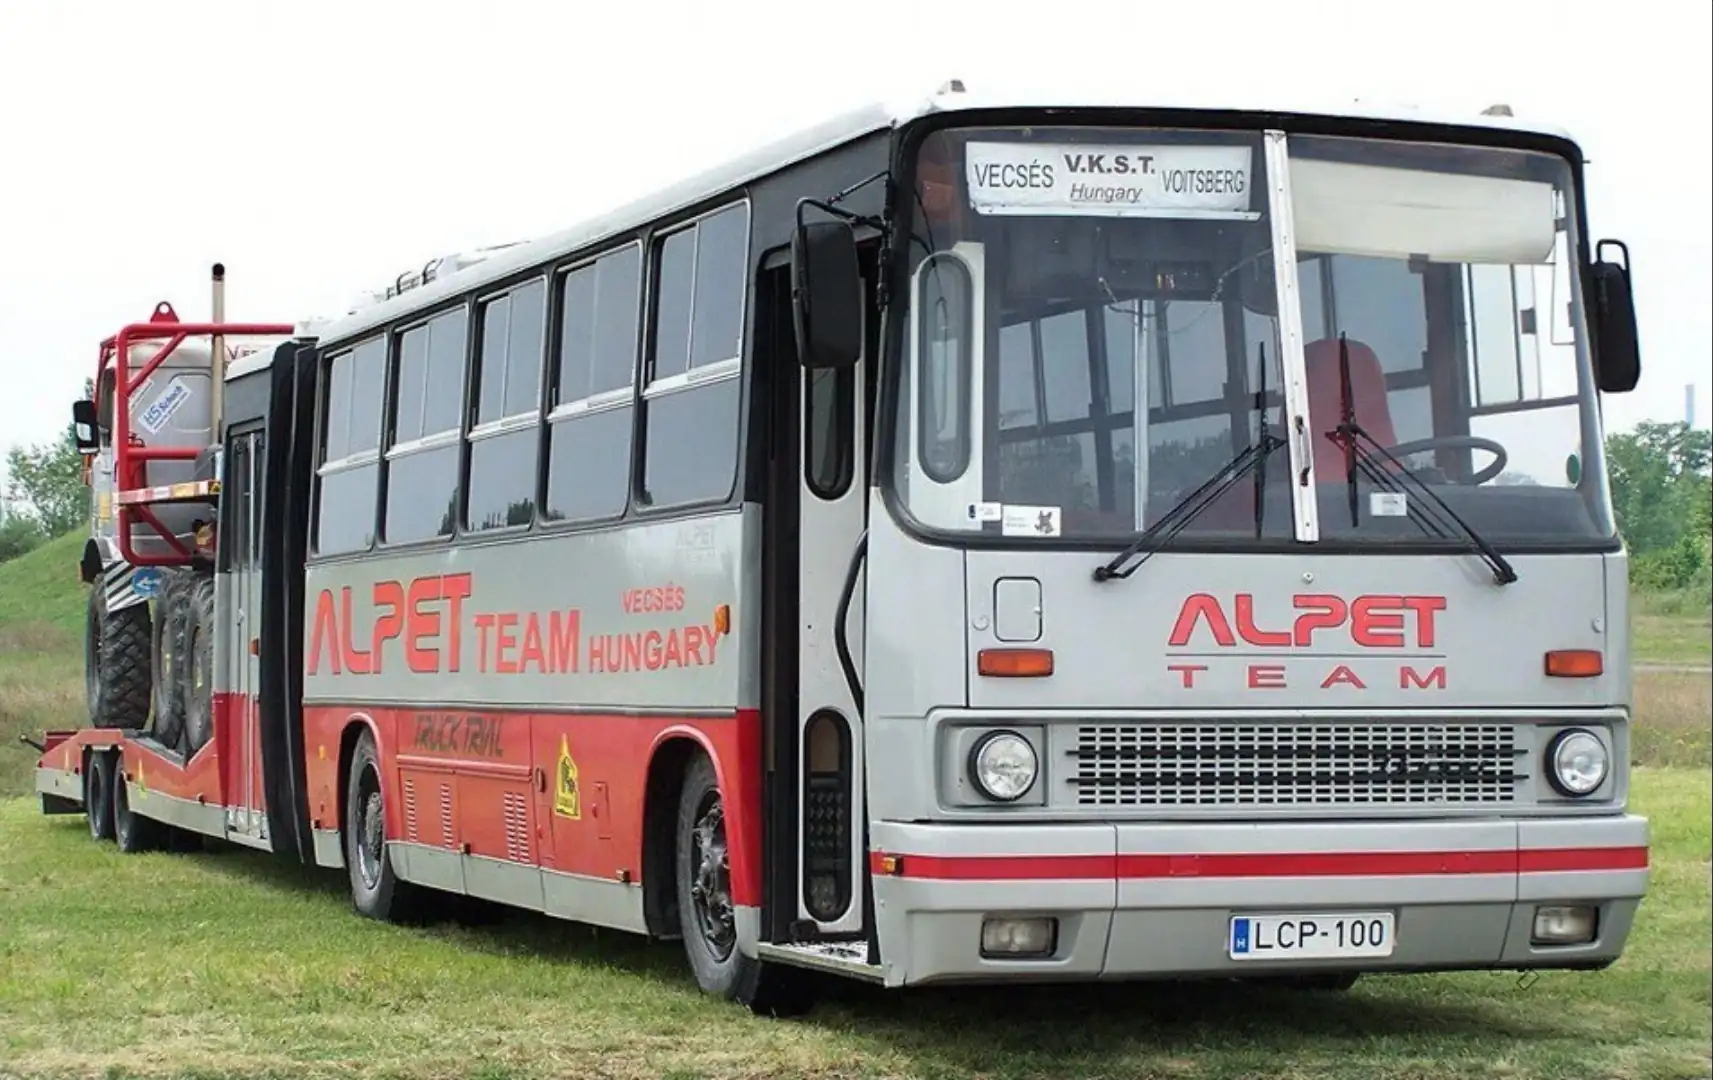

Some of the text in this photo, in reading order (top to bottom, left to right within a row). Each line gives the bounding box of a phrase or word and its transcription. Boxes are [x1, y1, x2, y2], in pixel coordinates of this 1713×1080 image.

[974, 159, 1054, 188] VECSÉS
[1064, 153, 1155, 175] V.K.S.T.
[1069, 183, 1143, 203] Hungary
[1161, 169, 1245, 194] VOITSBERG
[622, 580, 685, 613] VECSÉS
[307, 572, 719, 676] ALPET TEAM HUNGARY
[1167, 593, 1447, 648] ALPET
[1167, 664, 1447, 689] TEAM
[414, 713, 460, 753] TRUCK
[1237, 939, 1246, 948] H
[1255, 919, 1385, 950] LCP-100
